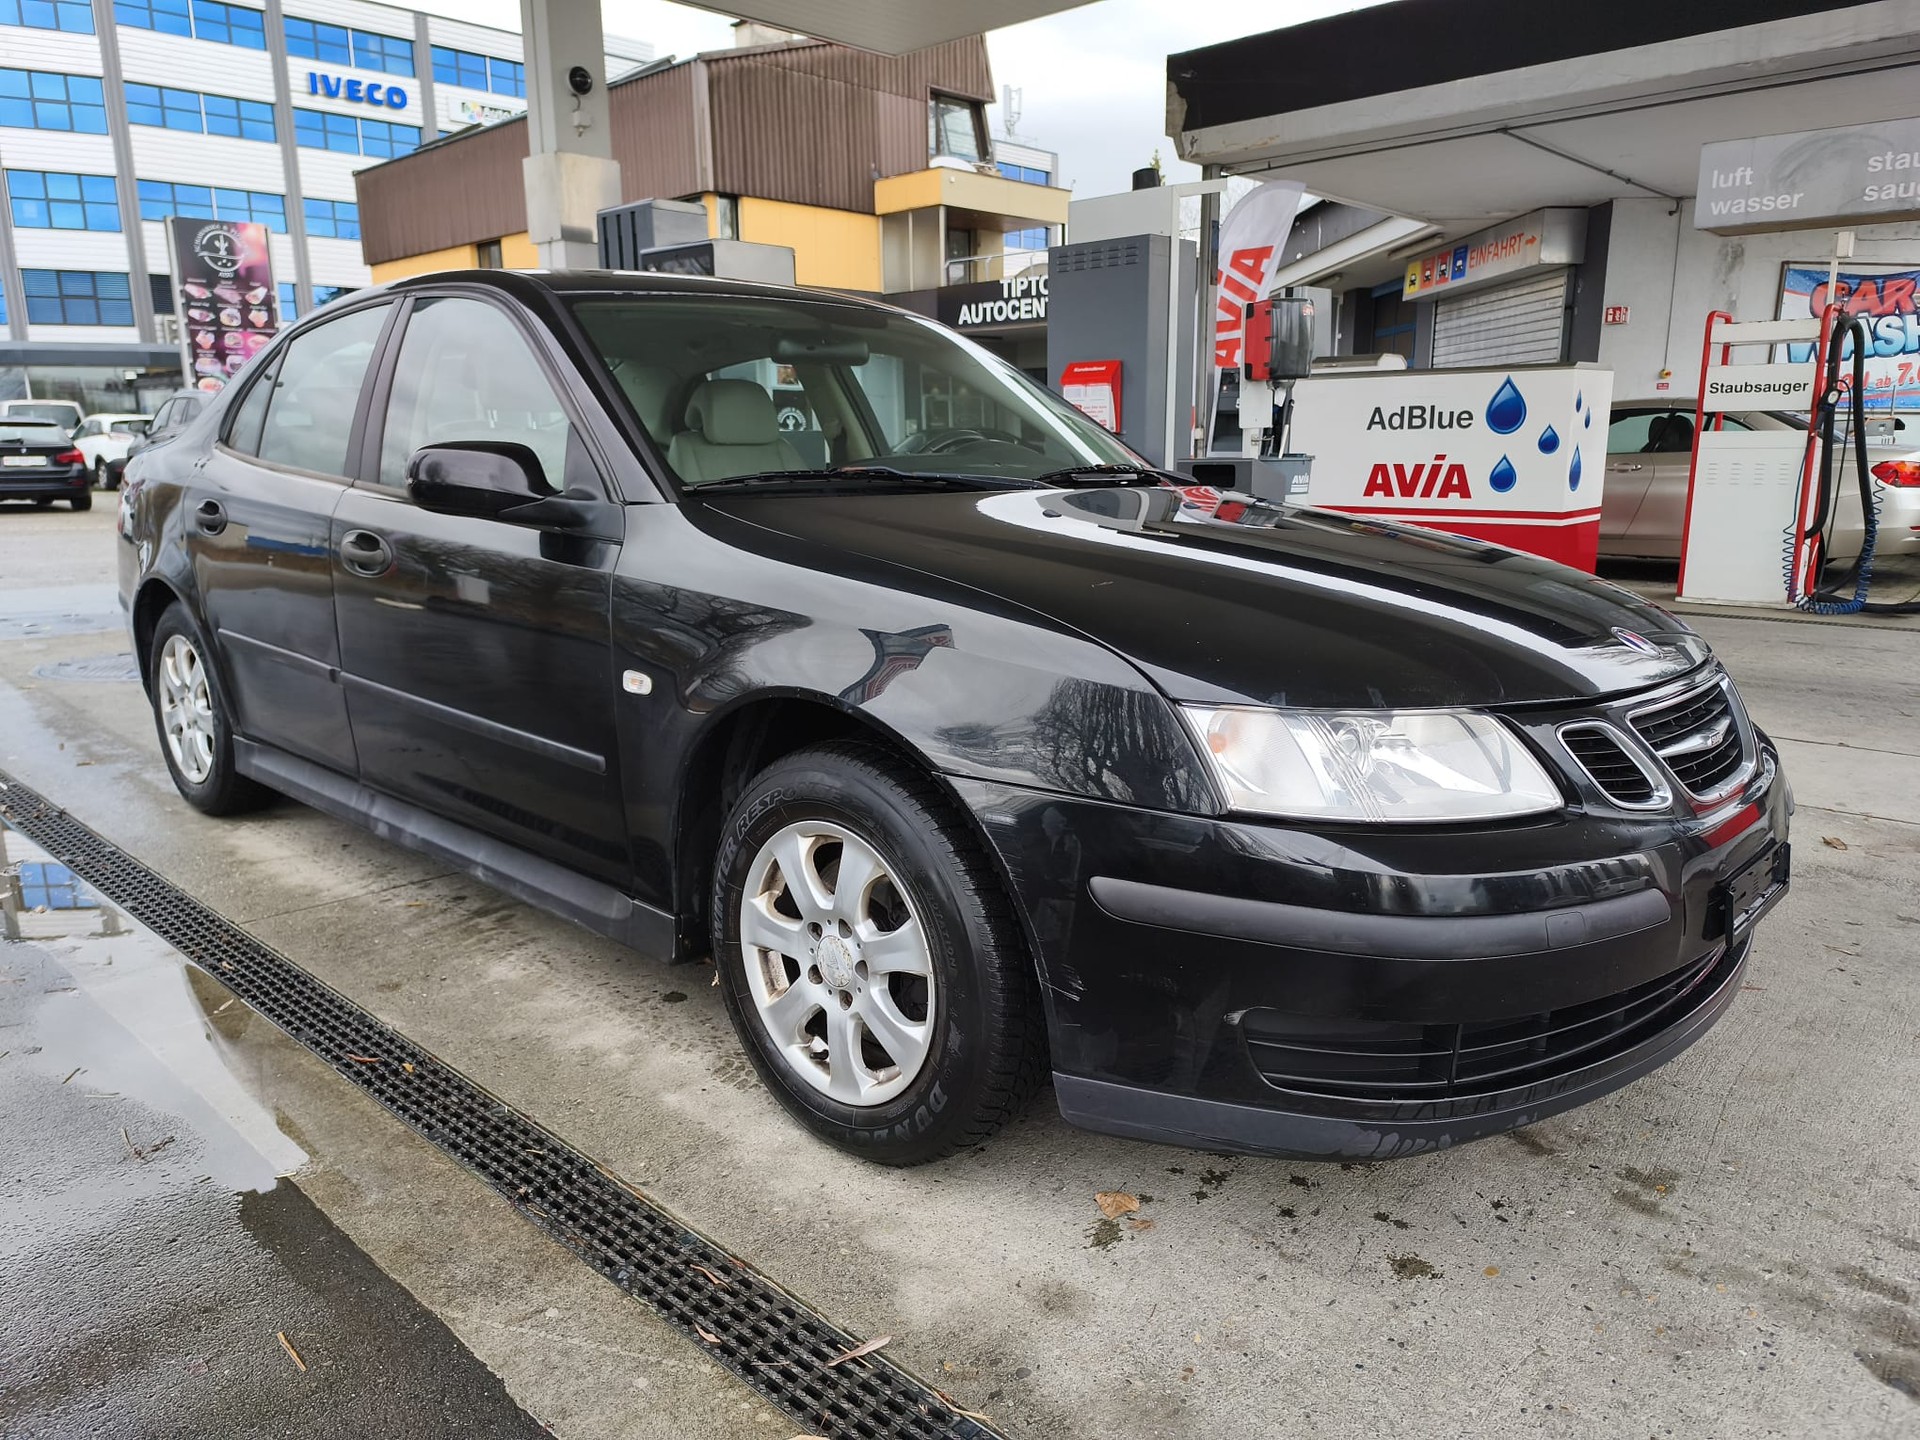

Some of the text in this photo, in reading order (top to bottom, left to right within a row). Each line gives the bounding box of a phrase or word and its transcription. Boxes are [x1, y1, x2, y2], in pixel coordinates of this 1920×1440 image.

[308, 72, 407, 110] IVECO
[1711, 166, 1754, 189] luft
[1710, 192, 1804, 215] wasser
[1863, 181, 1920, 202] sau
[1469, 232, 1525, 269] EINFAHRT
[1215, 245, 1274, 368] AVIA
[1809, 278, 1917, 319] CAR
[1709, 381, 1809, 395] Staubsauger
[1875, 374, 1892, 389] ab
[1366, 405, 1474, 430] AdBlue
[1363, 454, 1472, 499] AVIA
